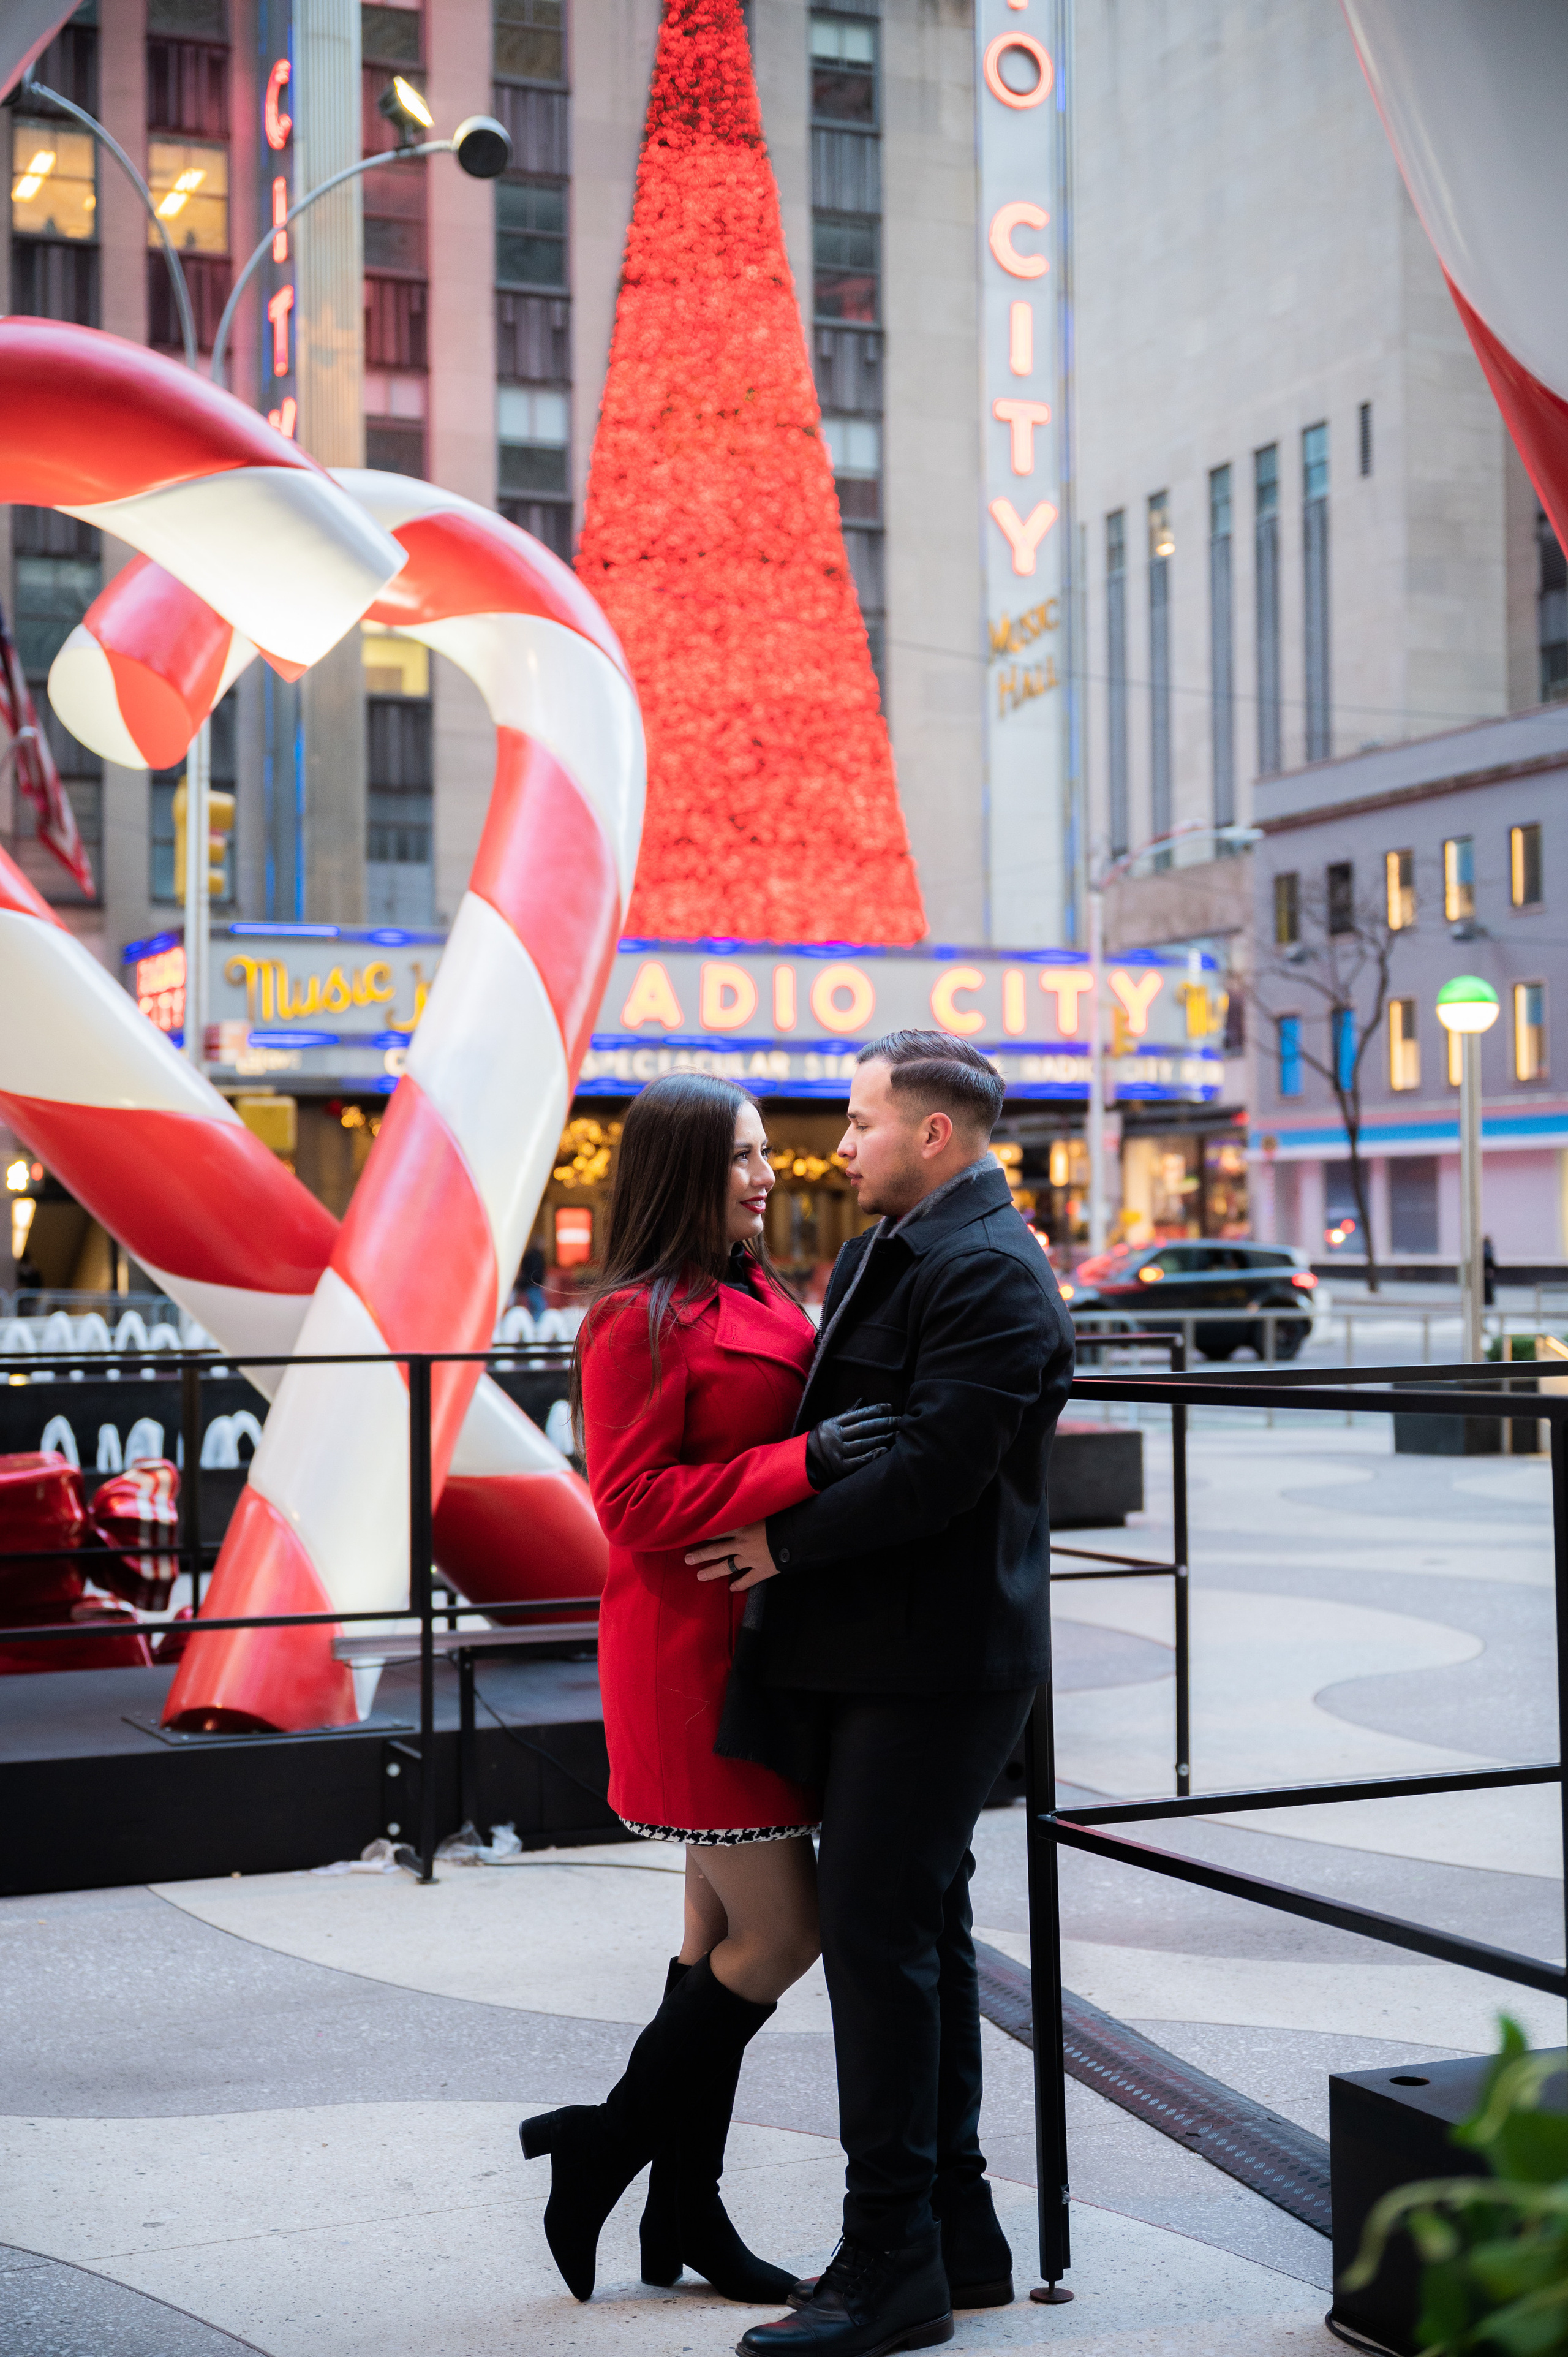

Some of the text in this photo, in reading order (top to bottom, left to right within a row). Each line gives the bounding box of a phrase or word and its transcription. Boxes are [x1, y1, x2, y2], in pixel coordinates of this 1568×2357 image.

[988, 200, 1058, 577] CITY
[987, 597, 1060, 666] MUSIC
[997, 655, 1060, 721] HALL
[224, 953, 396, 1023] Music
[620, 959, 875, 1034] ADIO
[930, 966, 1163, 1037] CITY
